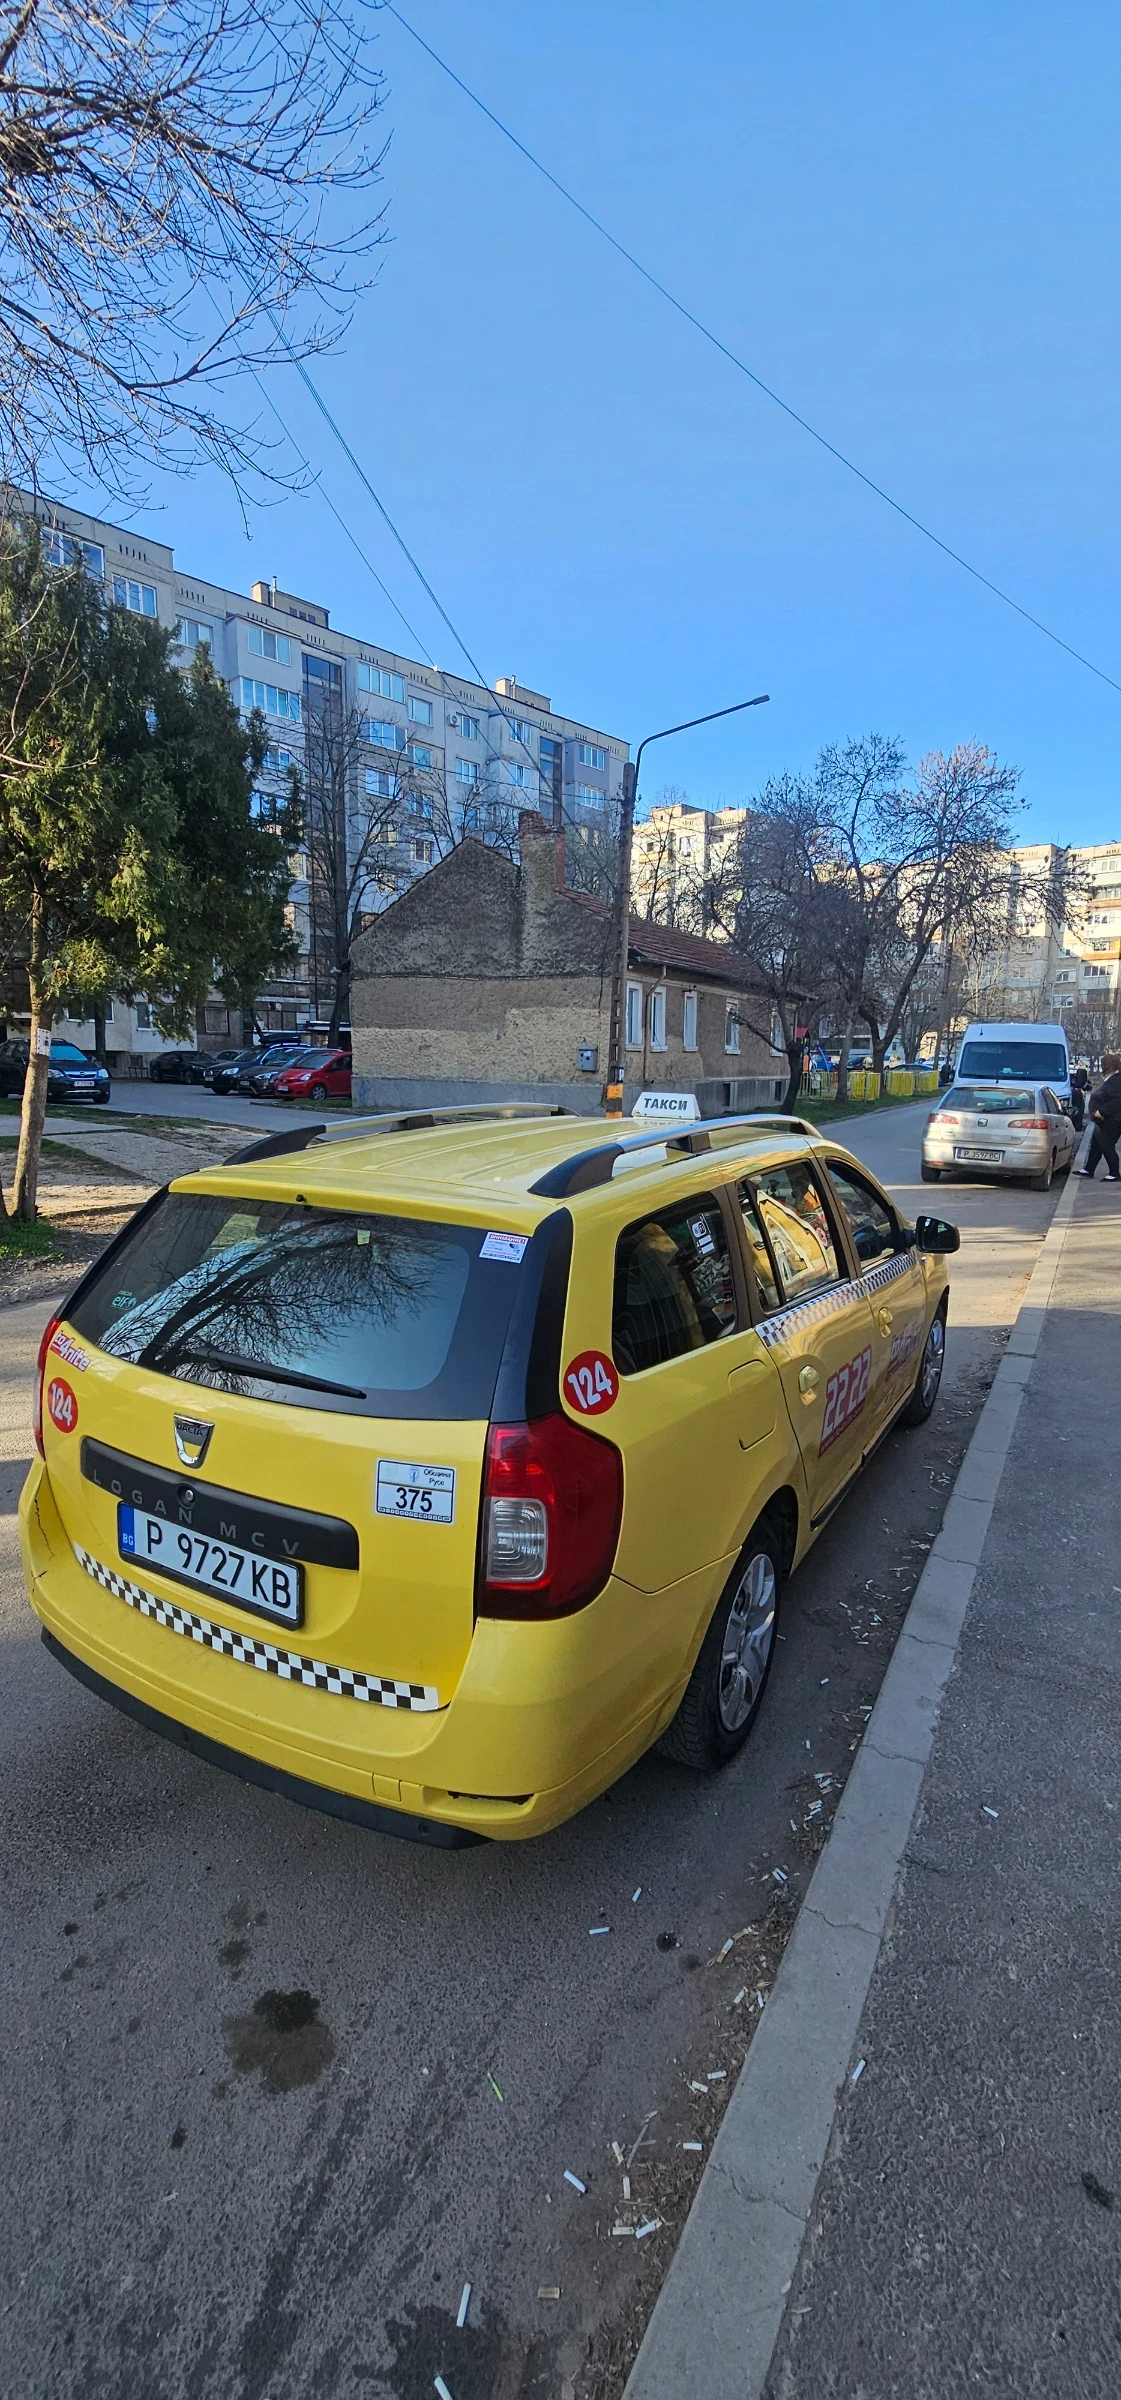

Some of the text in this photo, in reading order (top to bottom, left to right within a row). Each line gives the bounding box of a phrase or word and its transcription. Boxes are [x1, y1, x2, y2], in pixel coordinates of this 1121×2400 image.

[644, 1098, 688, 1111] ТАКСИ
[567, 1360, 613, 1409] 124
[51, 1382, 73, 1427] 124
[176, 1424, 204, 1437] DACIA
[93, 1469, 300, 1556] LOGAN MCV
[395, 1487, 433, 1513] 375
[122, 1532, 134, 1546] BG
[146, 1518, 292, 1610] P 9727 KB
